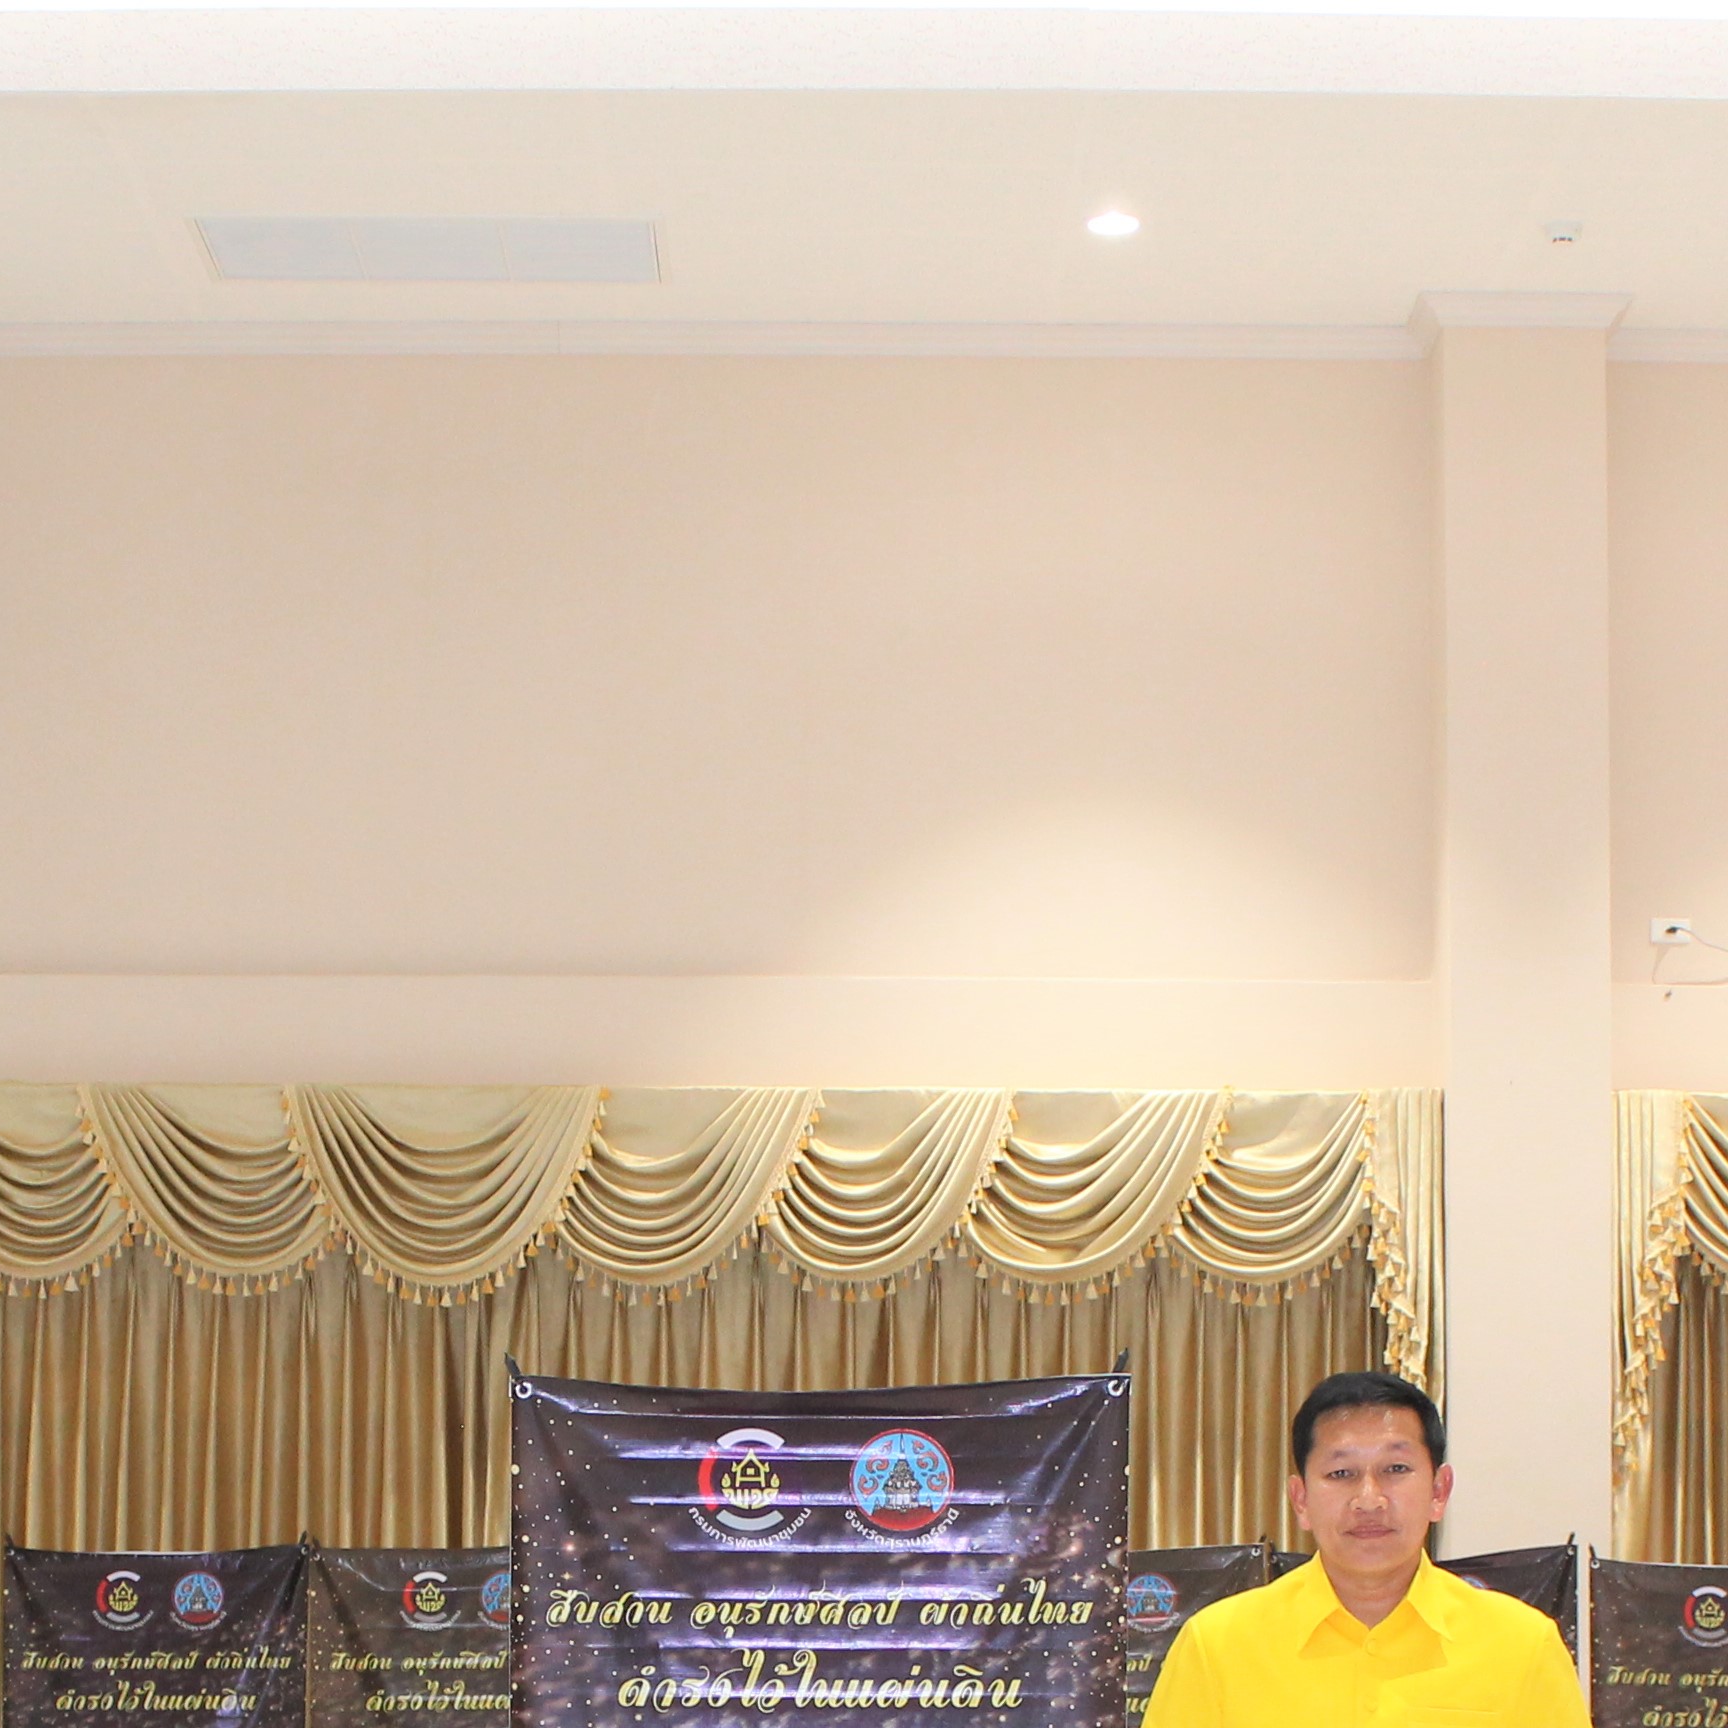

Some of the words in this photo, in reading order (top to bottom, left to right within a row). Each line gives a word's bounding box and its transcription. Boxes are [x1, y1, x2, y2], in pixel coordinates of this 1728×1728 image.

[545, 1590, 671, 1628] สืบสาน
[690, 1581, 897, 1639] อนุรักษ์ศิลป์
[617, 1649, 1022, 1714] ดำรงไว้ในแผ่นดิน
